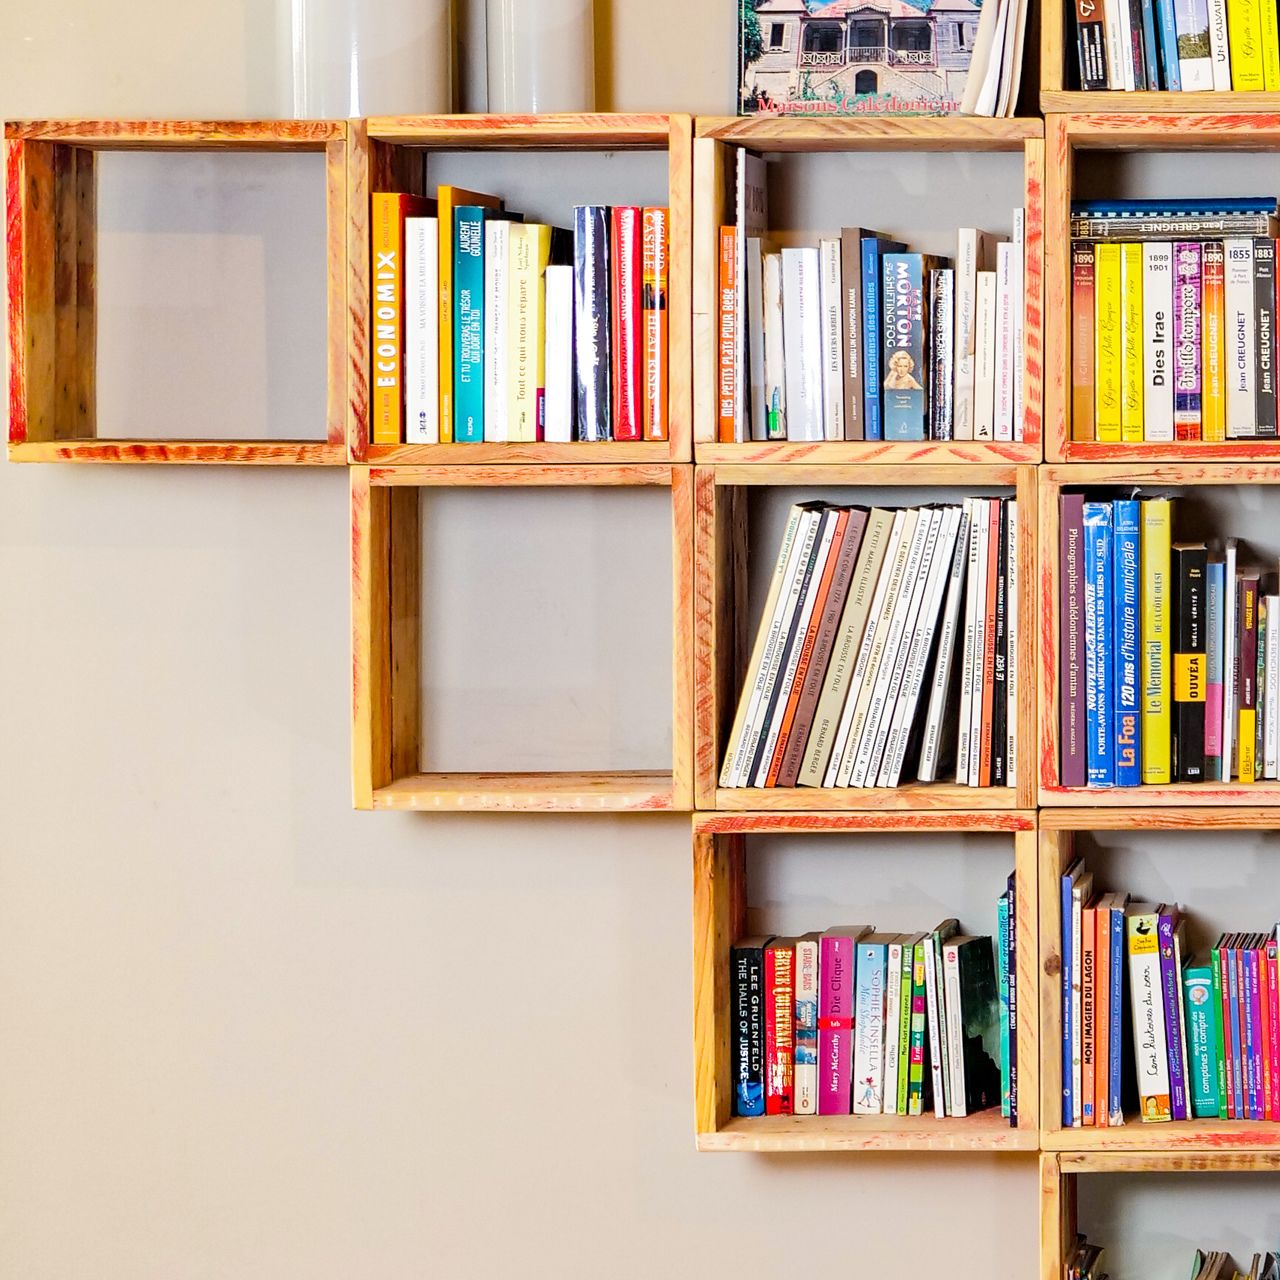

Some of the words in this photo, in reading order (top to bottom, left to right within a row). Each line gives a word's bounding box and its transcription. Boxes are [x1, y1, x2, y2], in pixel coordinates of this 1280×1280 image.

[460, 221, 470, 252] LAURENT
[471, 221, 481, 256] GOUNELLE
[1229, 250, 1250, 259] 1855
[1255, 249, 1273, 258] 1883
[460, 290, 470, 314] TRÉSOR
[517, 279, 528, 314] répare
[885, 276, 896, 323] SHIFTING
[896, 262, 910, 347] MORTON
[377, 251, 396, 387] ECONOMIX
[471, 310, 480, 320] TOI
[1181, 287, 1198, 341] tempore
[471, 322, 480, 331] EN
[886, 325, 896, 348] FOG
[1152, 311, 1165, 343] Irae
[462, 325, 470, 362] TROUVERAS
[471, 333, 480, 351] DORT
[1237, 310, 1246, 369] CREUGNET
[1260, 309, 1270, 370] CREUGNET
[471, 352, 481, 364] QUI
[517, 346, 528, 362] qui
[462, 364, 470, 373] TU
[462, 374, 470, 382] ET
[518, 365, 526, 377] ce
[1153, 350, 1165, 386] Dies
[517, 380, 526, 400] Tout
[1238, 372, 1248, 391] Jean
[1262, 372, 1272, 393] Jean
[1097, 539, 1105, 556] SUD
[1097, 559, 1105, 575] DU
[1124, 541, 1140, 604] municipale
[1097, 577, 1105, 598] MERS
[1097, 600, 1105, 617] LES
[808, 625, 817, 636] LA
[1123, 606, 1135, 660] d'histoire
[801, 637, 815, 666] BROUSSE
[798, 667, 807, 676] EN
[1096, 642, 1106, 693] AMÉRICAIN
[1124, 663, 1135, 685] ans
[1146, 640, 1162, 697] Mémorial
[1187, 657, 1200, 699] OUVÉA
[1123, 687, 1135, 707] 120
[1147, 701, 1162, 714] Le
[1098, 694, 1106, 755] PORTE-AVIONS
[1118, 716, 1135, 745] Foa
[1118, 748, 1135, 767] La
[738, 958, 747, 980] THE
[750, 966, 759, 990] LEE
[775, 950, 792, 985] BRYCE
[831, 958, 843, 991] Clique
[1084, 950, 1093, 984] LAGON
[739, 984, 748, 1018] HALLS
[870, 969, 882, 1012] SOPHIE
[1084, 986, 1092, 1000] DU
[1144, 991, 1152, 1006] du
[831, 996, 841, 1013] Die
[740, 1021, 748, 1034] OF
[773, 986, 791, 1048] COURTENAY
[1084, 1001, 1093, 1040] IMAGIER
[1198, 1011, 1209, 1044] compter
[750, 995, 760, 1071] GRUENFELD
[869, 1015, 881, 1072] KINSELLA
[739, 1036, 749, 1080] JUSTICE
[831, 1033, 840, 1070] McCarthy
[1084, 1042, 1093, 1065] MON
[1146, 1052, 1159, 1076] Cent
[1199, 1054, 1210, 1094] comptines
[831, 1072, 840, 1092] Mary
